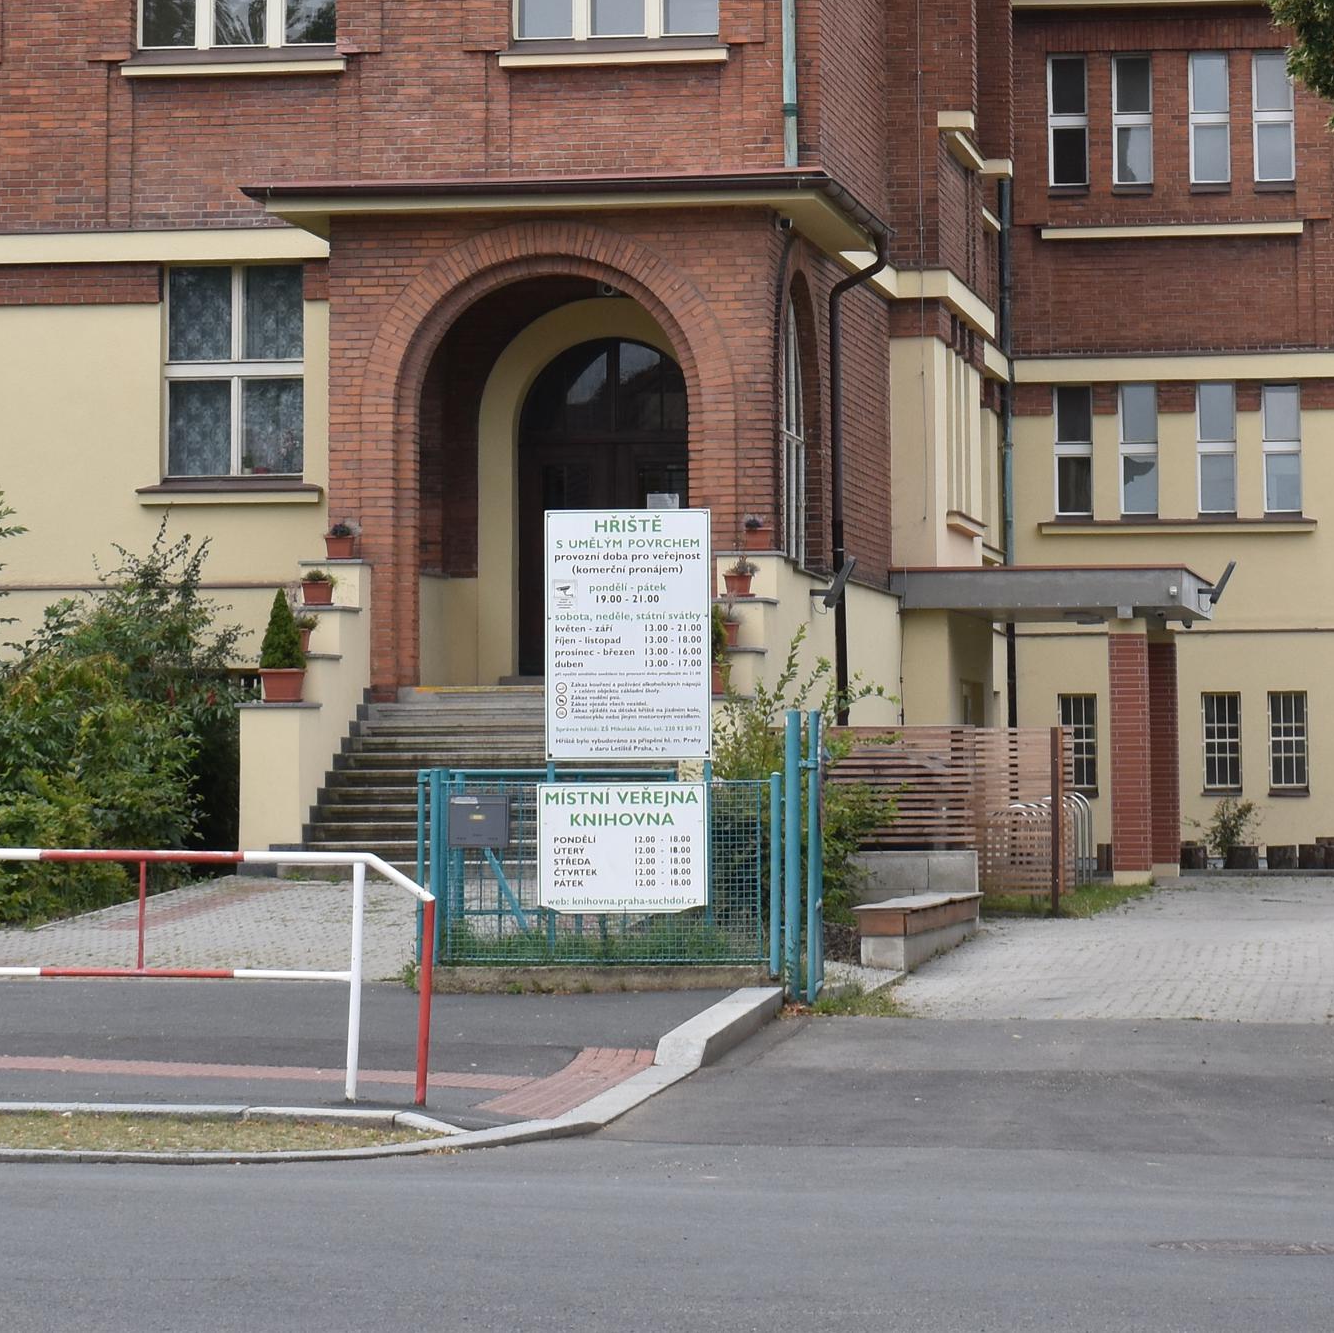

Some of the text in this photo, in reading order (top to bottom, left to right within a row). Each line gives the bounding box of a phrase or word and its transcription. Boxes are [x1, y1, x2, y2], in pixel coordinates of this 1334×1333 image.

[594, 515, 662, 533] HŘIŠTĚ
[556, 537, 700, 548] S UMĚLÝM POVRCHEM
[554, 552, 701, 563] provozní doba pro veřejnost
[571, 564, 683, 575] (komerční pronájem)
[589, 583, 627, 593] pondělí
[637, 583, 667, 592] pátek
[595, 595, 622, 603] 19.00
[633, 595, 659, 603] 21.00
[555, 612, 701, 622] sobota, neděle, státní svátky
[555, 637, 576, 646] říjen
[585, 636, 621, 646] listopad
[555, 648, 594, 657] prosinec
[603, 648, 635, 656] březen
[555, 660, 583, 668] duben
[678, 659, 702, 667] 17.00
[545, 787, 698, 807] MÍSTNÍ VEŘEJNÁ
[570, 813, 674, 826] KNIHOVNA
[554, 835, 596, 843] PONDĚLÍ
[554, 847, 584, 855] ÚTERÝ
[554, 858, 591, 866] STŘEDA
[670, 857, 691, 865] 18.00
[554, 868, 597, 876] ČTVRTEK
[635, 868, 656, 876] 12.00
[554, 879, 583, 887] PÁTEK
[635, 879, 656, 887] 12.00
[547, 897, 697, 906] web: knihovna.praha-suchdol.cz
